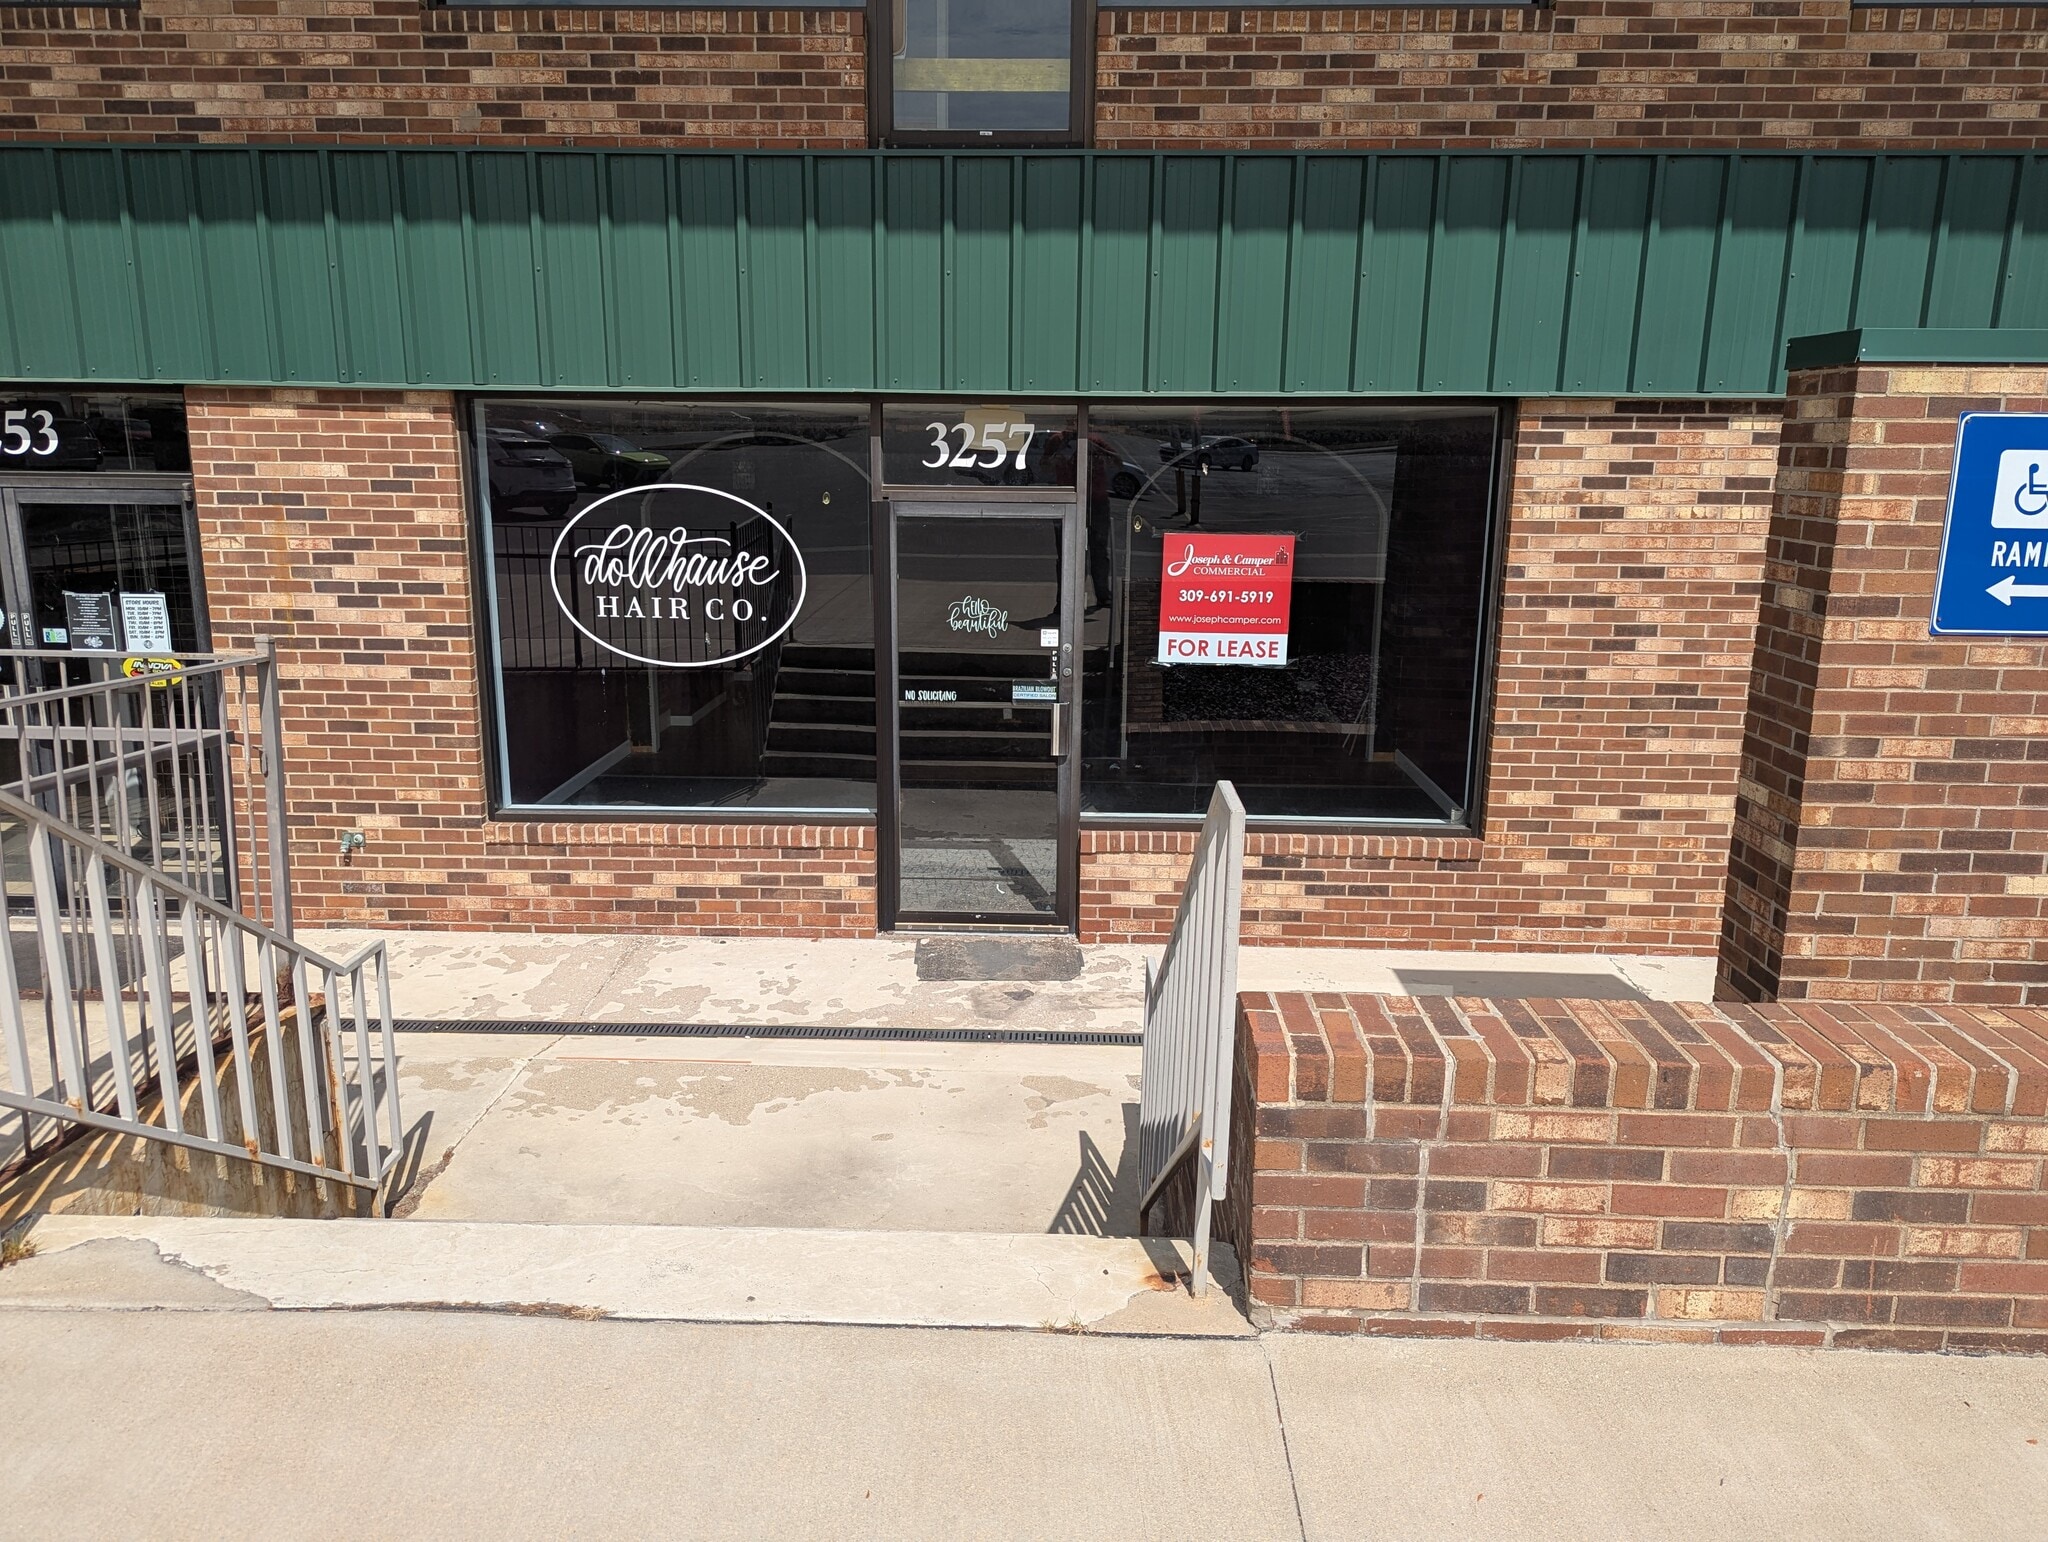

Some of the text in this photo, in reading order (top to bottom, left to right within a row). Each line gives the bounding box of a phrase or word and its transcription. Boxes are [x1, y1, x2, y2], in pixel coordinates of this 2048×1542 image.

[0, 408, 59, 456] 53
[922, 421, 1035, 470] 3257
[1167, 543, 1275, 577] Joseph & Camper
[1193, 566, 1266, 576] COMMERCIAL
[596, 595, 768, 622] HAIR CO.
[1178, 589, 1274, 604] 309-691-5919
[10, 613, 18, 637] PULL
[23, 613, 31, 638] PULL
[946, 606, 1009, 639] beautiful
[1168, 614, 1282, 625] www.josephcamper.com
[1167, 638, 1279, 659] FOR LEASE
[905, 689, 957, 702] NO SOLICITING
